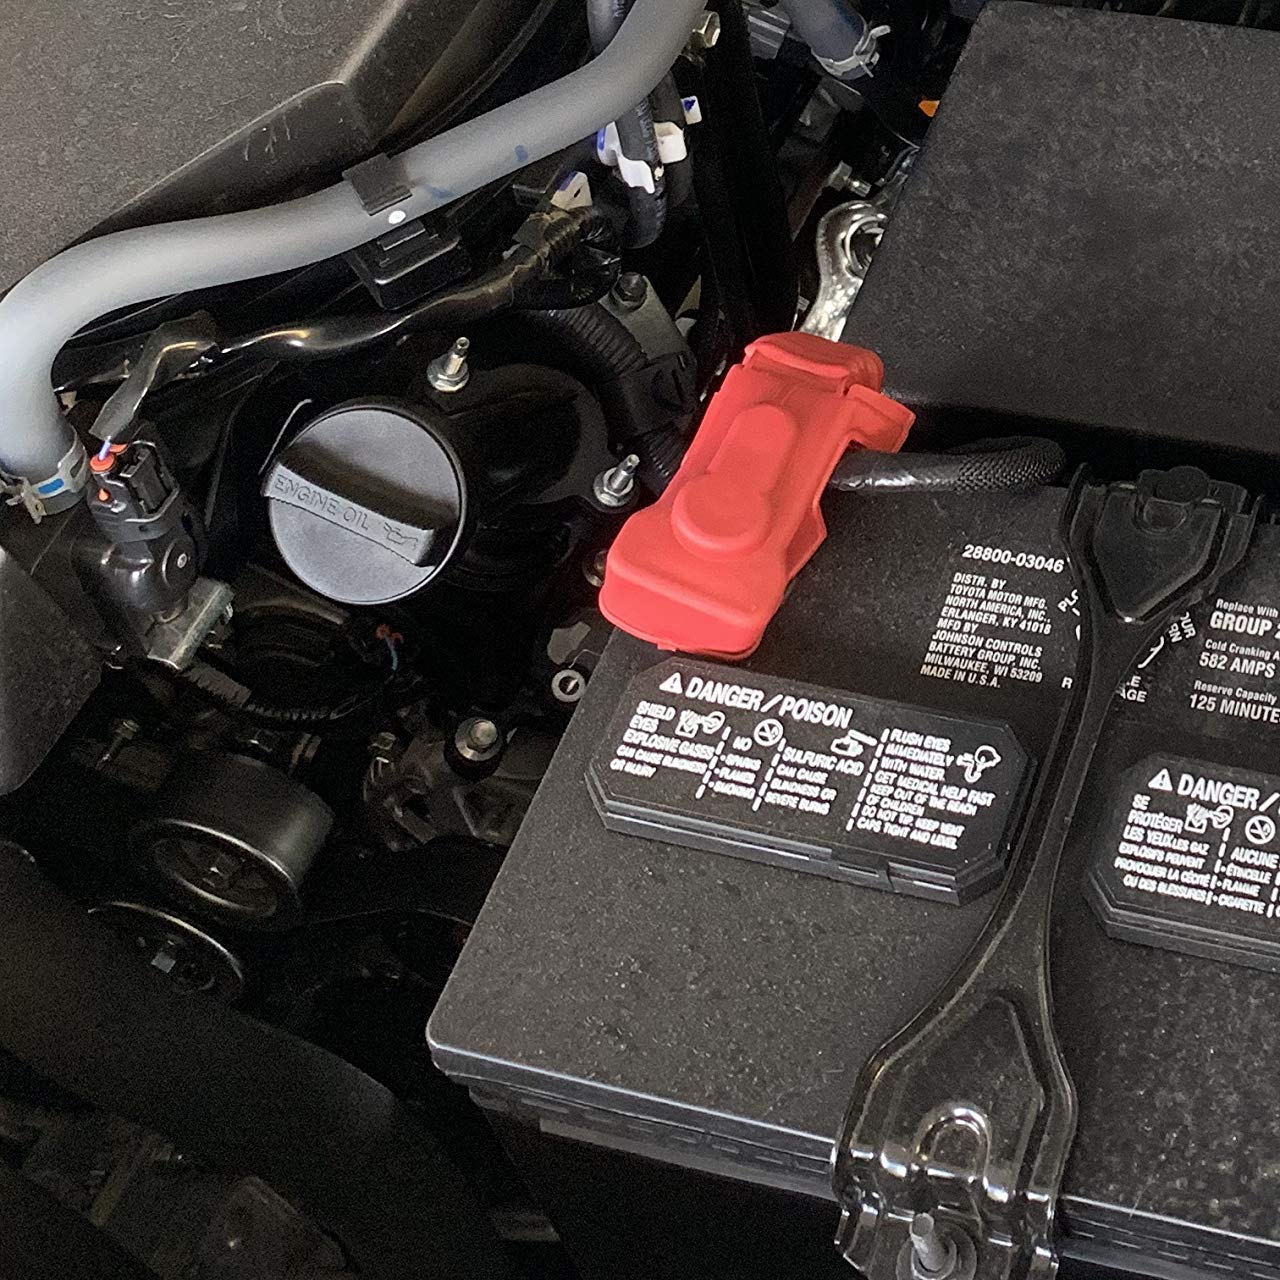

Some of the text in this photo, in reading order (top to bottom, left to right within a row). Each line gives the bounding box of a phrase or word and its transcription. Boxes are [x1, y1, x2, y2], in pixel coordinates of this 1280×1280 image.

[274, 473, 370, 532] ENGINE OIL
[962, 544, 1065, 573] 28800-03046
[953, 572, 1007, 590] DISTR. BY
[945, 595, 979, 609] NORTH
[979, 602, 1024, 619] AMERICA,
[950, 584, 986, 599] TOYOTA
[988, 590, 1023, 605] MOTOR
[1024, 596, 1048, 609] MFG.
[1216, 598, 1279, 618] Replace With
[937, 618, 979, 633] MFD BY
[941, 606, 1052, 635] ERLANGER, KY 41018
[1209, 610, 1273, 639] GROUP
[929, 641, 976, 658] BATTERY
[1019, 658, 1041, 670] INC.
[932, 630, 1042, 658] JOHNSON CONTROLS
[1205, 638, 1226, 652] Cold
[1228, 642, 1271, 661] Cranking
[920, 664, 1000, 688] MADE IN U.S.A.
[925, 652, 1043, 683] MILWAUKEE, WI 53209
[1199, 651, 1276, 679] 582 AMPS
[1189, 694, 1216, 712] 125
[1194, 680, 1277, 706] Reserve Capacity
[636, 701, 676, 721] SHIELD
[629, 714, 659, 733] EYES
[623, 728, 716, 760] EXPLOSIVE GASES
[732, 736, 752, 751] NO
[890, 728, 951, 752] FLUSH EYES
[782, 746, 864, 776] SULFURIC ACID
[880, 756, 908, 772] WITH
[885, 743, 954, 767] IMMEDIATELY
[776, 764, 797, 778] CAN
[866, 793, 880, 805] OF
[875, 769, 996, 807] GET MEDICAL HELP FAST
[894, 788, 915, 801] OUT
[914, 794, 929, 804] OF
[861, 805, 876, 818] DO
[876, 808, 898, 822] NOT
[1132, 793, 1151, 811] SE
[856, 817, 882, 832] CAPS
[1127, 808, 1184, 834] PROTÉGER
[1123, 824, 1145, 841] LES
[1189, 841, 1210, 856] GAZ
[1230, 846, 1280, 869] AUCUNE
[1123, 873, 1138, 888] OU
[1167, 867, 1181, 881] LA
